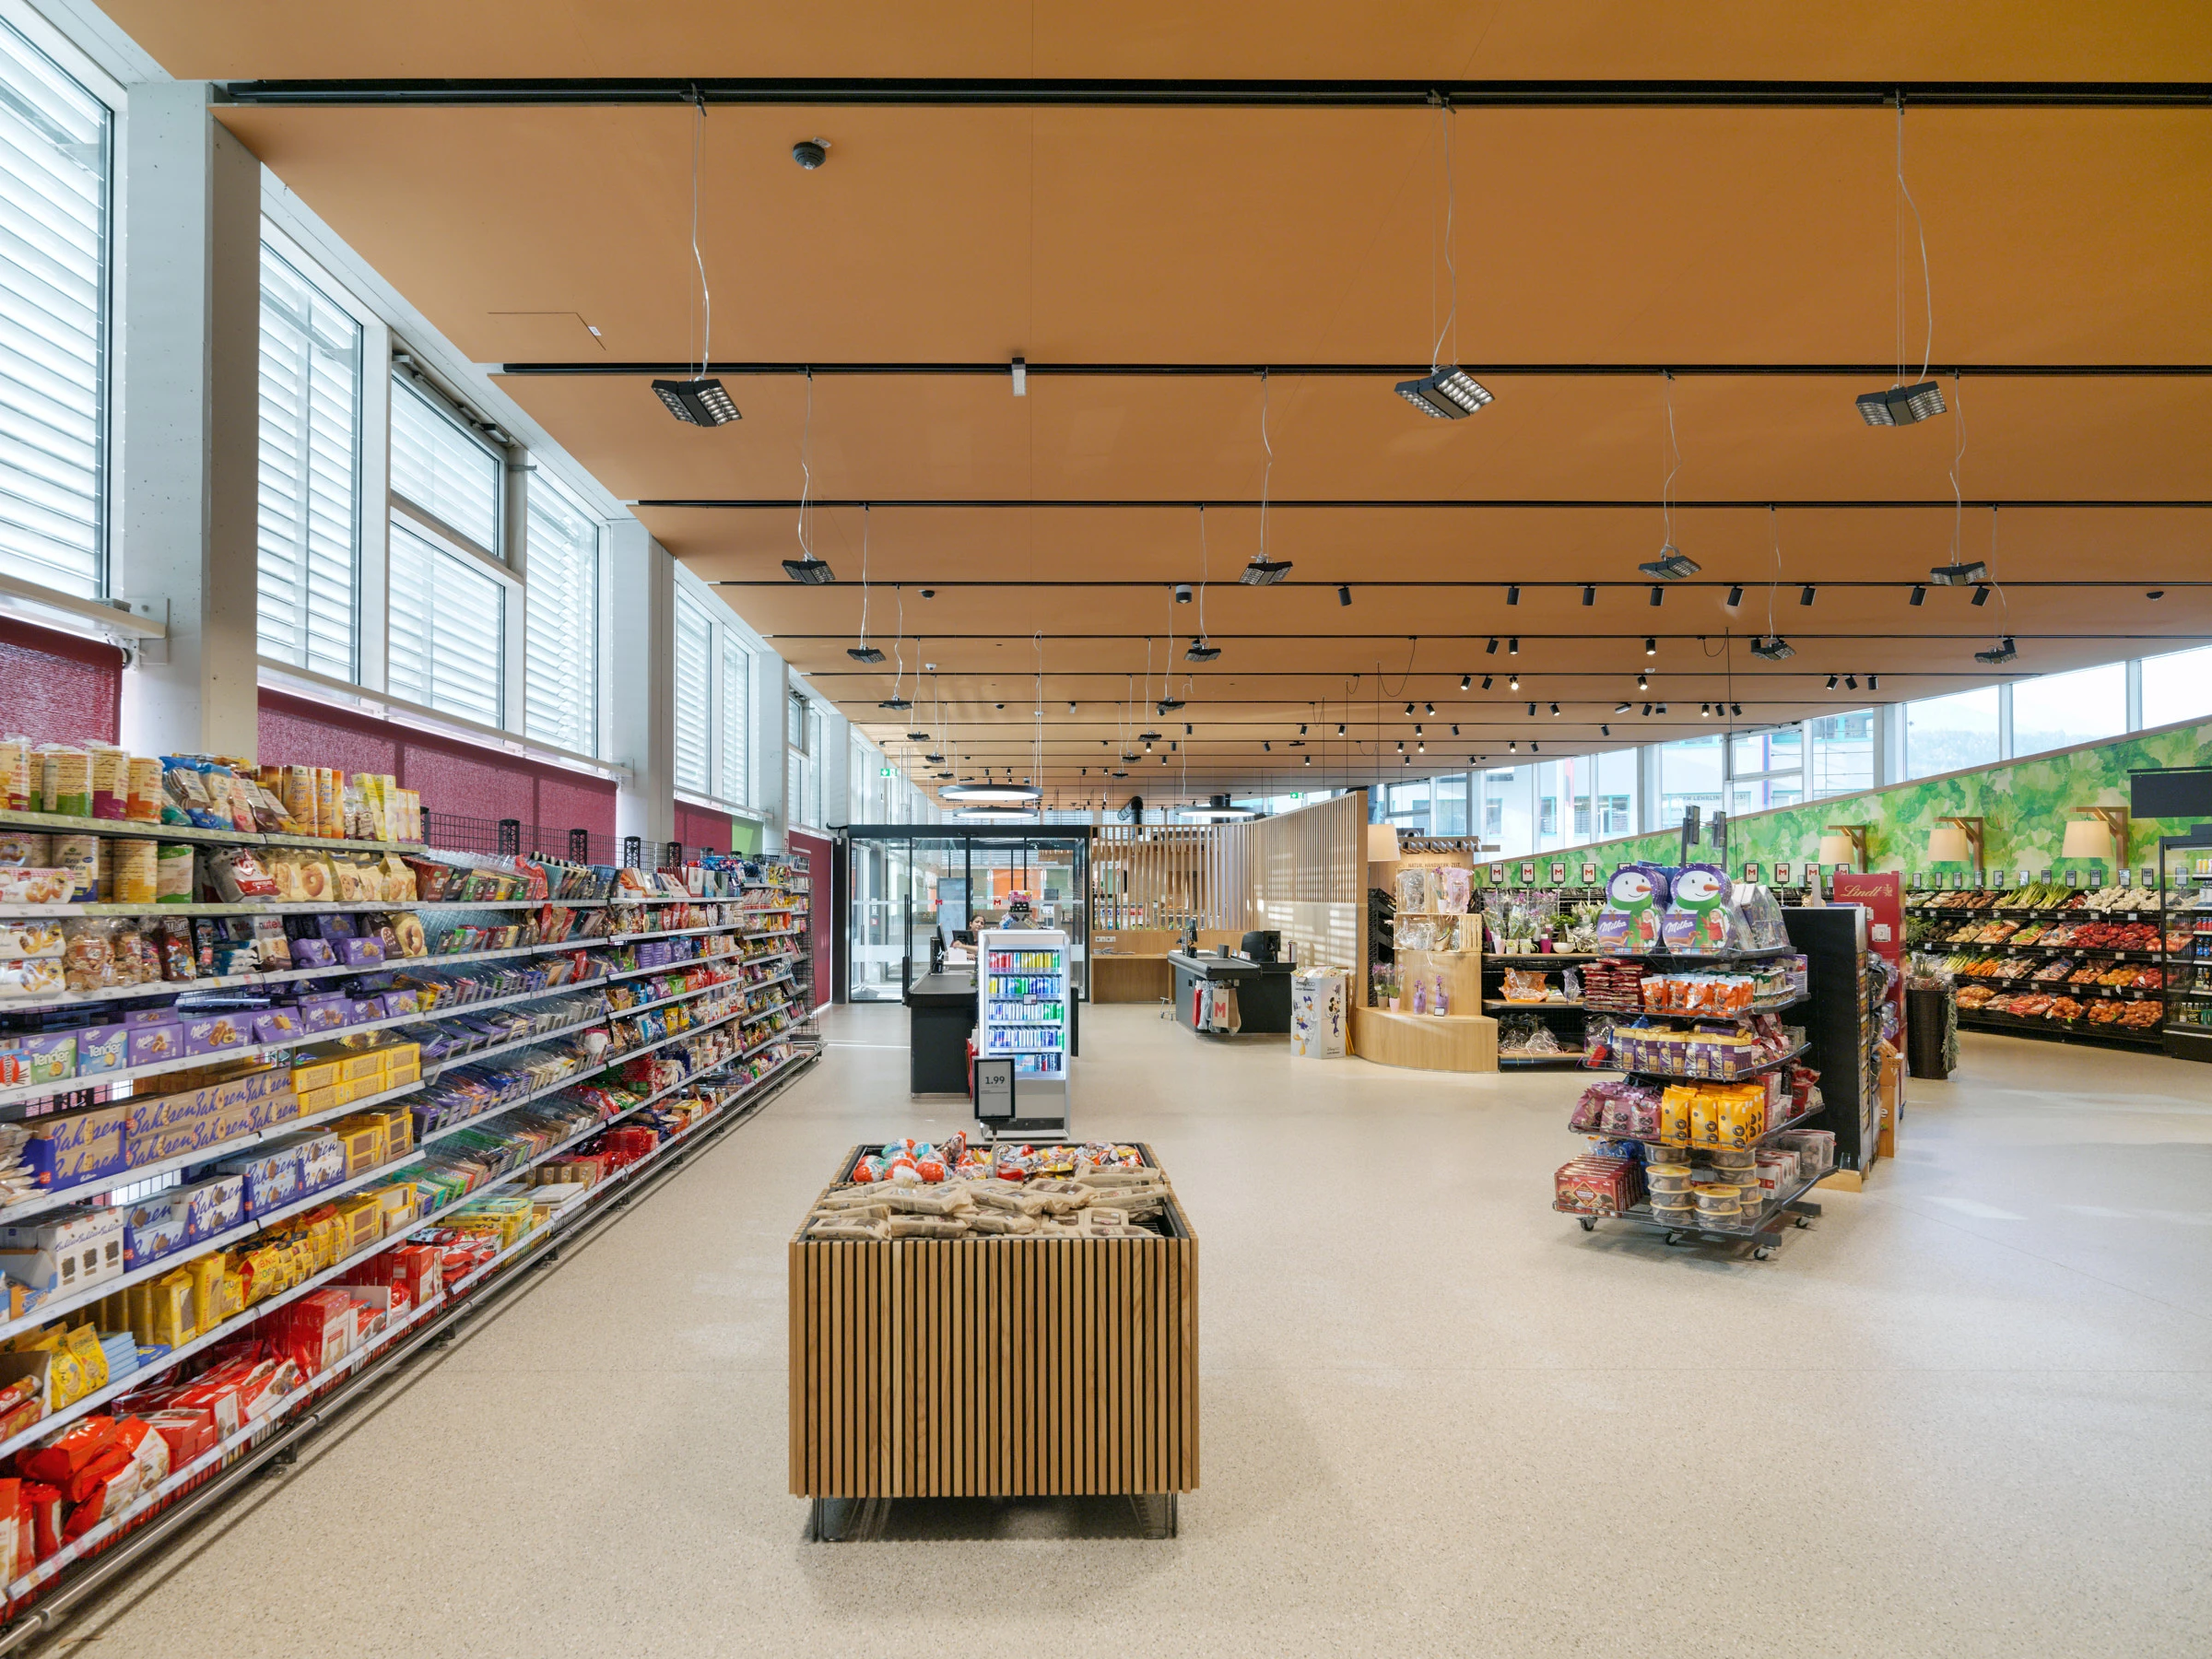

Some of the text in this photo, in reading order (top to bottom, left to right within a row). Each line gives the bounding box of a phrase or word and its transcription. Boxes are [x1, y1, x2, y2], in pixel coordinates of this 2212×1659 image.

[1840, 885, 1883, 897] Lindt
[1599, 920, 1627, 933] Milka
[1665, 920, 1694, 933] Milka
[1214, 1001, 1226, 1018] M
[32, 1049, 71, 1066] Tender
[88, 1041, 122, 1058] Tender
[3, 1054, 13, 1087] MIKADO
[985, 1076, 1006, 1084] 1.99
[195, 1088, 247, 1117] Bahsen
[245, 1074, 291, 1103] Bahsen
[129, 1102, 196, 1137] Bahsen
[248, 1101, 300, 1132] Bahsen
[53, 1117, 124, 1152] Bahsen
[191, 1117, 249, 1150] Bahsen
[125, 1134, 193, 1170] Bahsen
[194, 1182, 243, 1215] Bahsen
